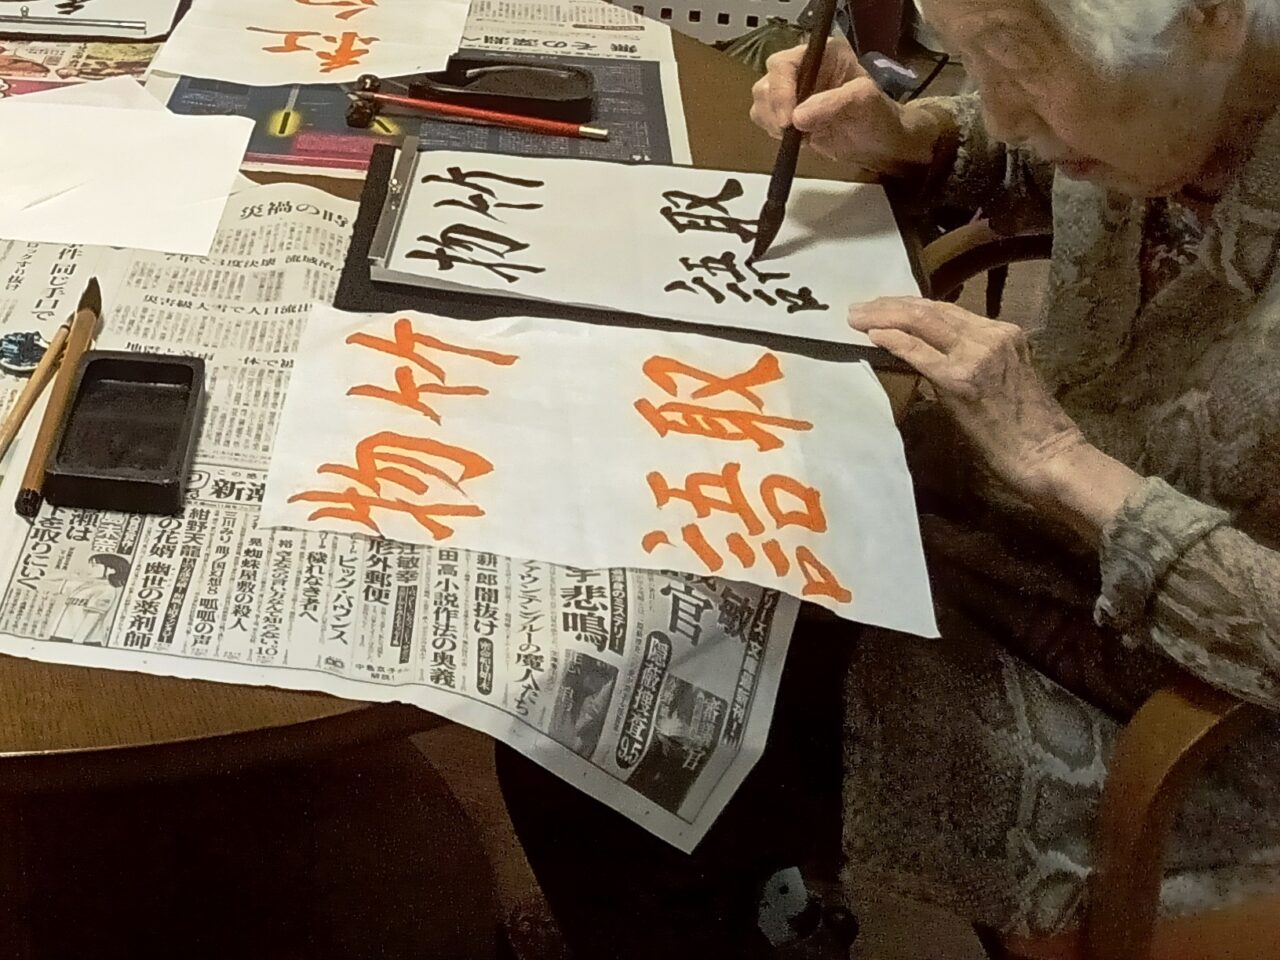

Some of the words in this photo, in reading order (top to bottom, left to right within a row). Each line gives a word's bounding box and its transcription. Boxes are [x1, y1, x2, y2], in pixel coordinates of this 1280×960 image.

[179, 507, 211, 558] 紺野天龍
[219, 511, 239, 543] 三川みり
[123, 561, 172, 650] 幽世の薬剤師
[228, 547, 264, 633] 蜘蛛屋敷の殺人
[298, 551, 328, 623] 穢れなき者へ
[328, 554, 359, 646] ビッグ・バウンス
[362, 540, 393, 607] 形外郵便
[429, 577, 461, 689] 小説作法の奥義
[560, 583, 610, 653] 悲鳴
